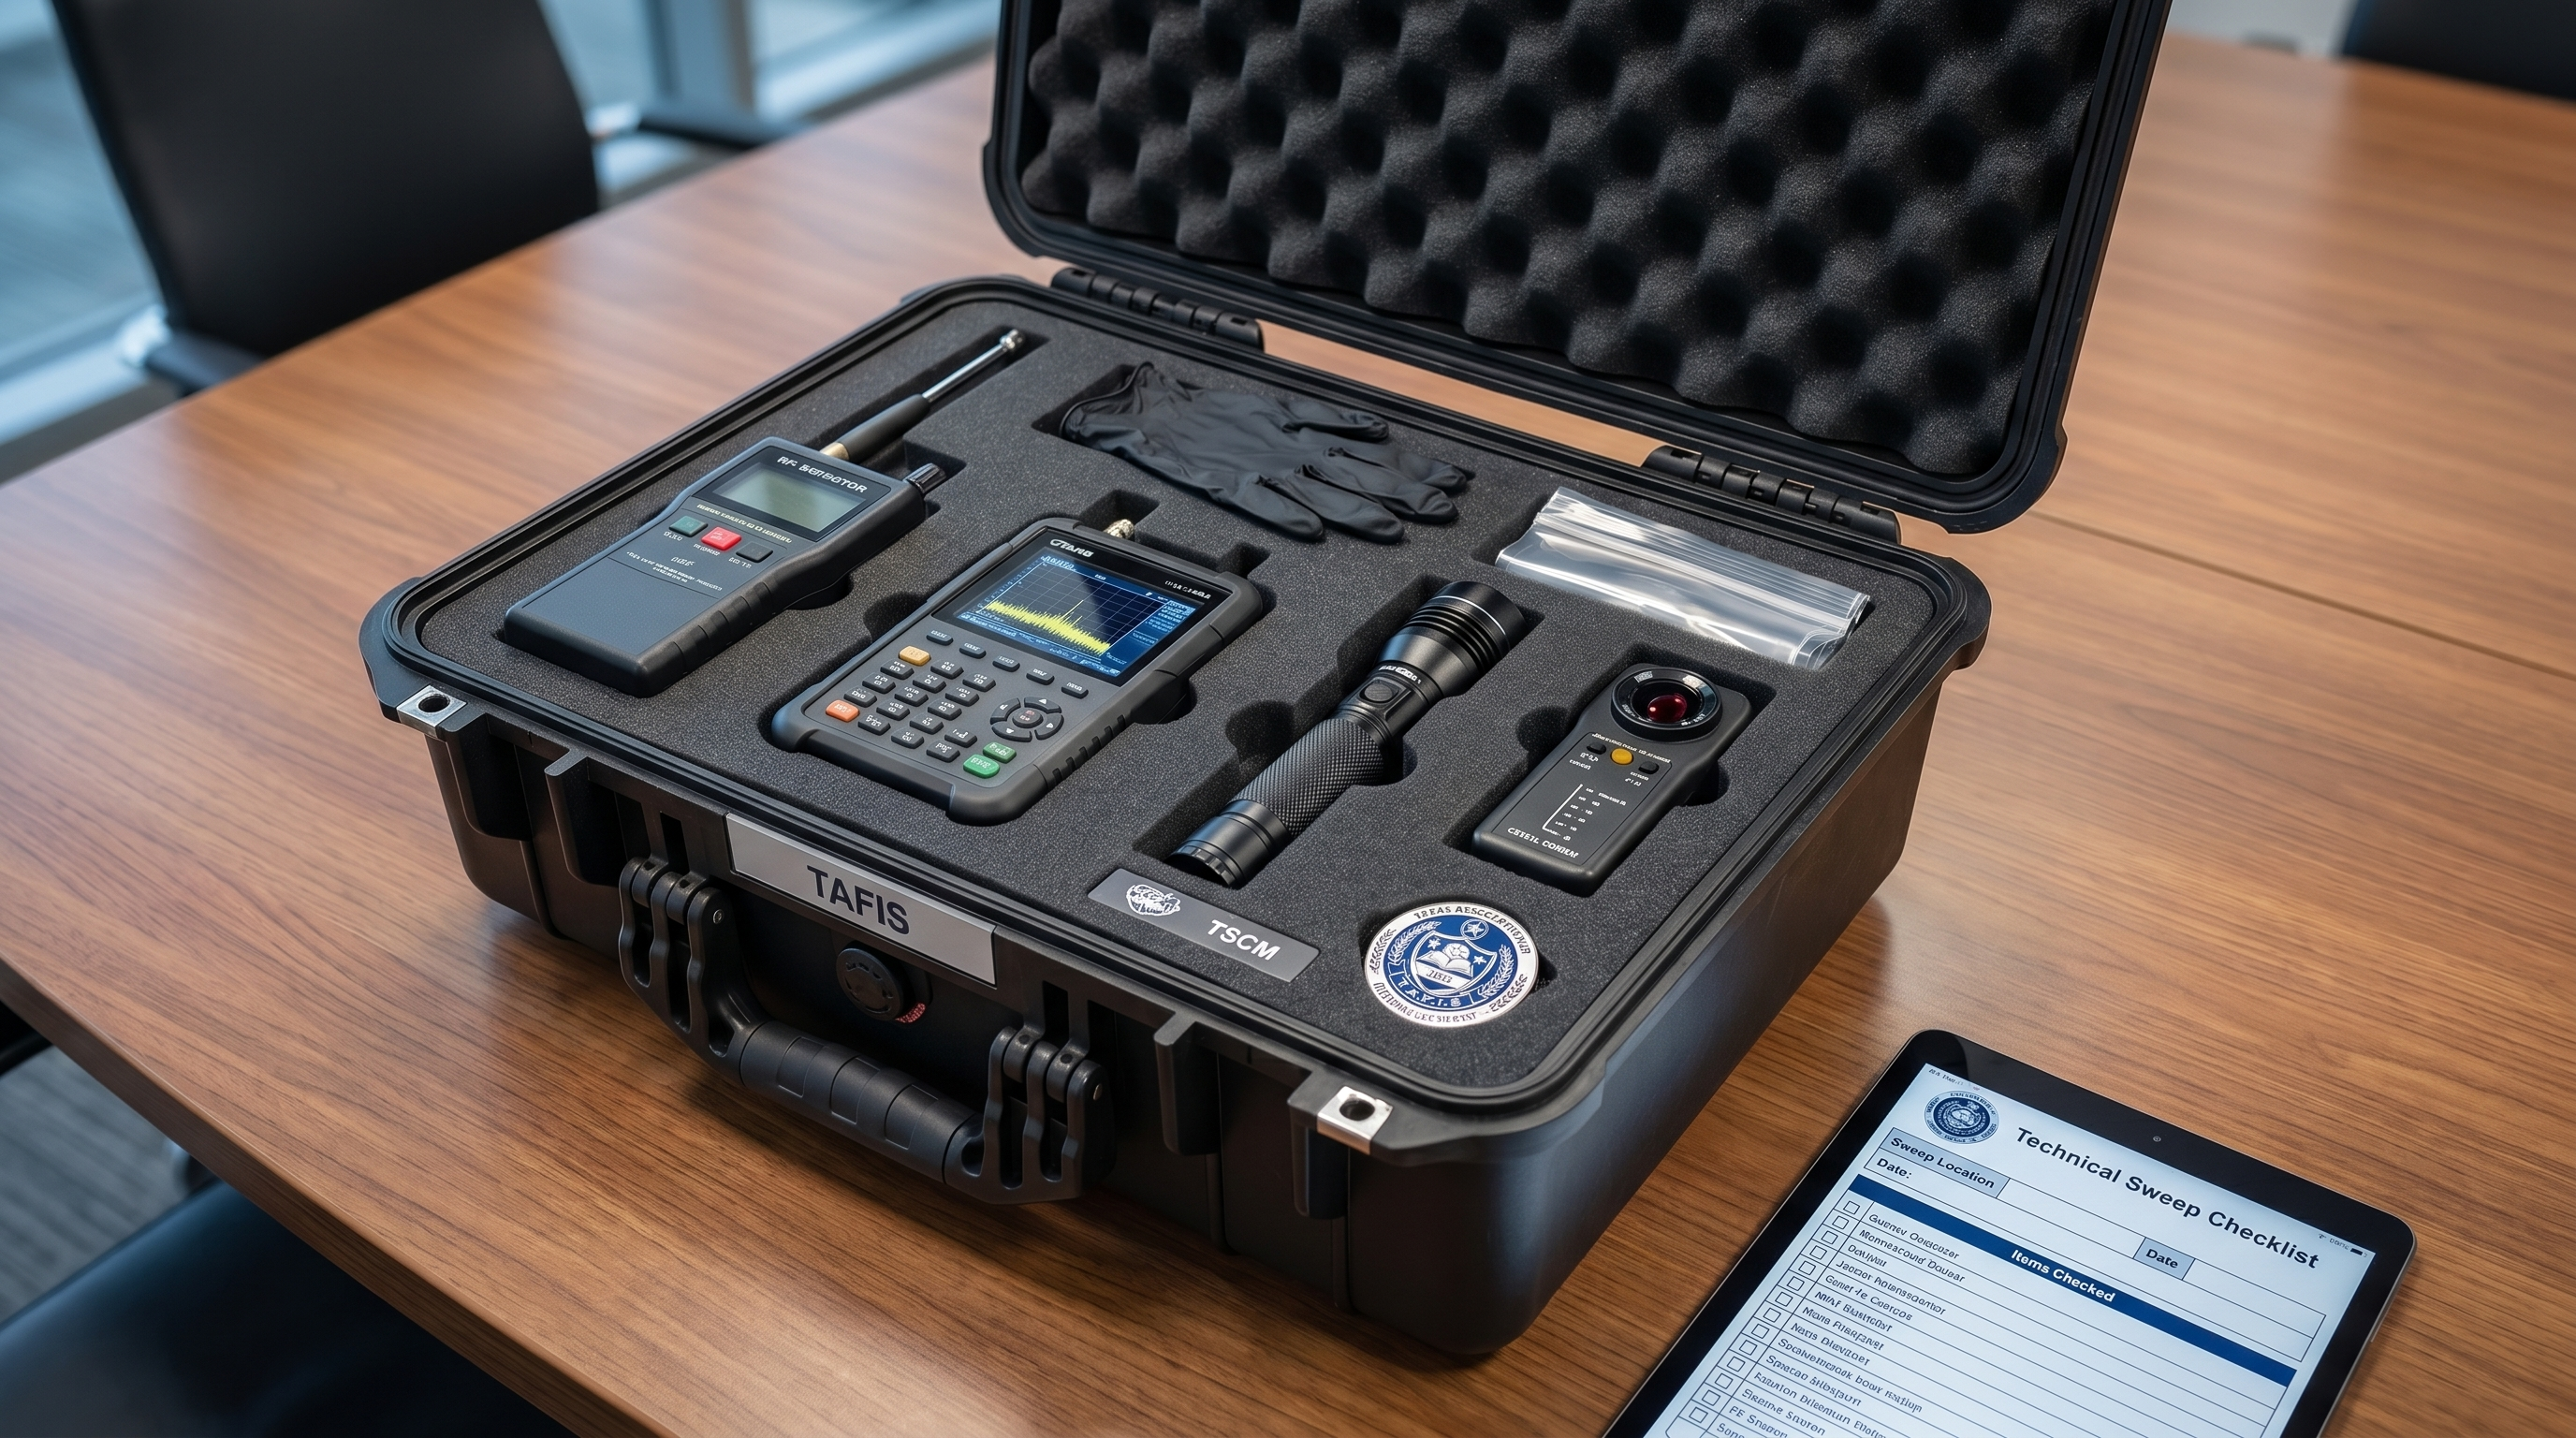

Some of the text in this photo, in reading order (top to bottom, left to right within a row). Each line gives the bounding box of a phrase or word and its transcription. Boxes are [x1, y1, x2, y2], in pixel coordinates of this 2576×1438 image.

[807, 864, 910, 935] TAFIS
[1207, 919, 1281, 961] TSCM
[1876, 1157, 1912, 1180] Date:
[1891, 1137, 1996, 1189] Sweep Location
[2015, 1127, 2320, 1269] Technical Sweep Checklist
[2011, 1249, 2115, 1302] Items Checked
[2145, 1248, 2179, 1269] Date
